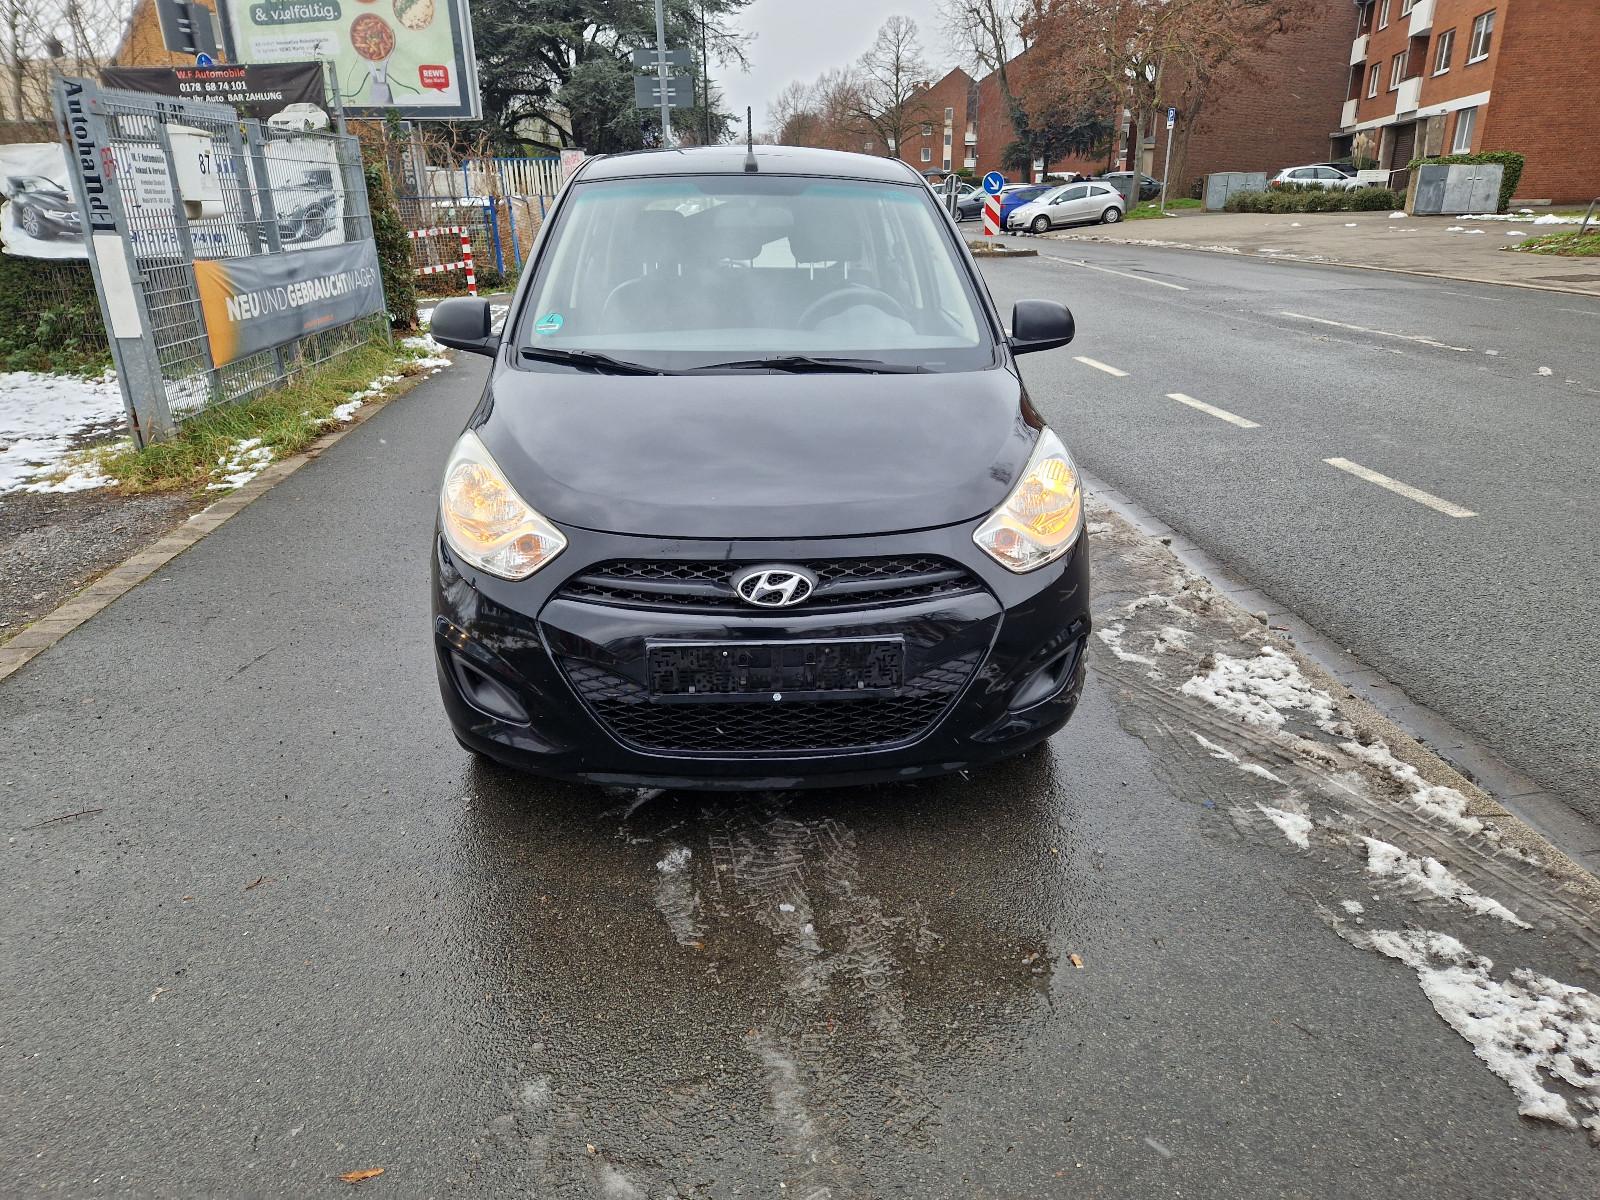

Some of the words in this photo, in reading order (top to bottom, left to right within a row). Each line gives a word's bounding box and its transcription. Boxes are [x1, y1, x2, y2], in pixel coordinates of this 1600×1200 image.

[255, 8, 268, 21] &
[271, 3, 338, 20] vielfältig.
[195, 69, 246, 79] Automobile
[423, 69, 445, 78] REWE
[179, 82, 202, 92] 0178
[205, 82, 217, 91] 68
[217, 82, 229, 91] 74
[230, 81, 248, 90] 101
[205, 94, 225, 103] Auto
[227, 93, 244, 102] BAR
[244, 92, 282, 101] ZAHLUNG
[198, 153, 211, 175] 87
